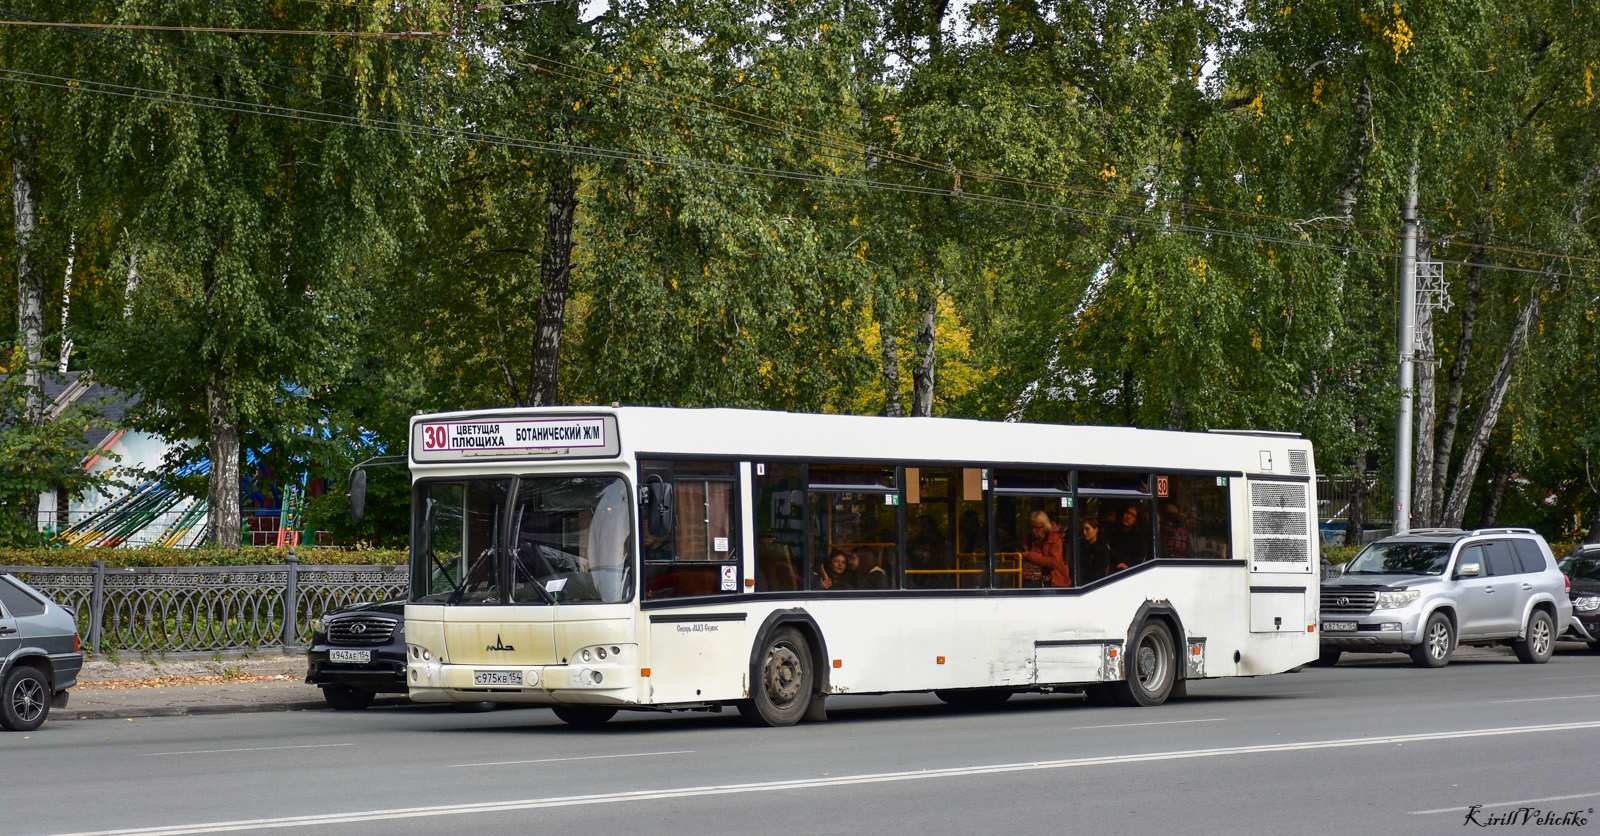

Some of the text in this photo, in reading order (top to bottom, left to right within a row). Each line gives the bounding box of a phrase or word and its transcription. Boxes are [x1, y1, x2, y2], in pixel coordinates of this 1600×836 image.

[456, 424, 500, 435] ЦВЕТУЩАЯ
[516, 424, 600, 441] БОТАНИЧЕСКИЙ Ж/М
[425, 426, 446, 448] 30
[452, 436, 505, 448] ПЛЮЩИХА
[1158, 479, 1167, 493] 30
[509, 672, 521, 681] 154
